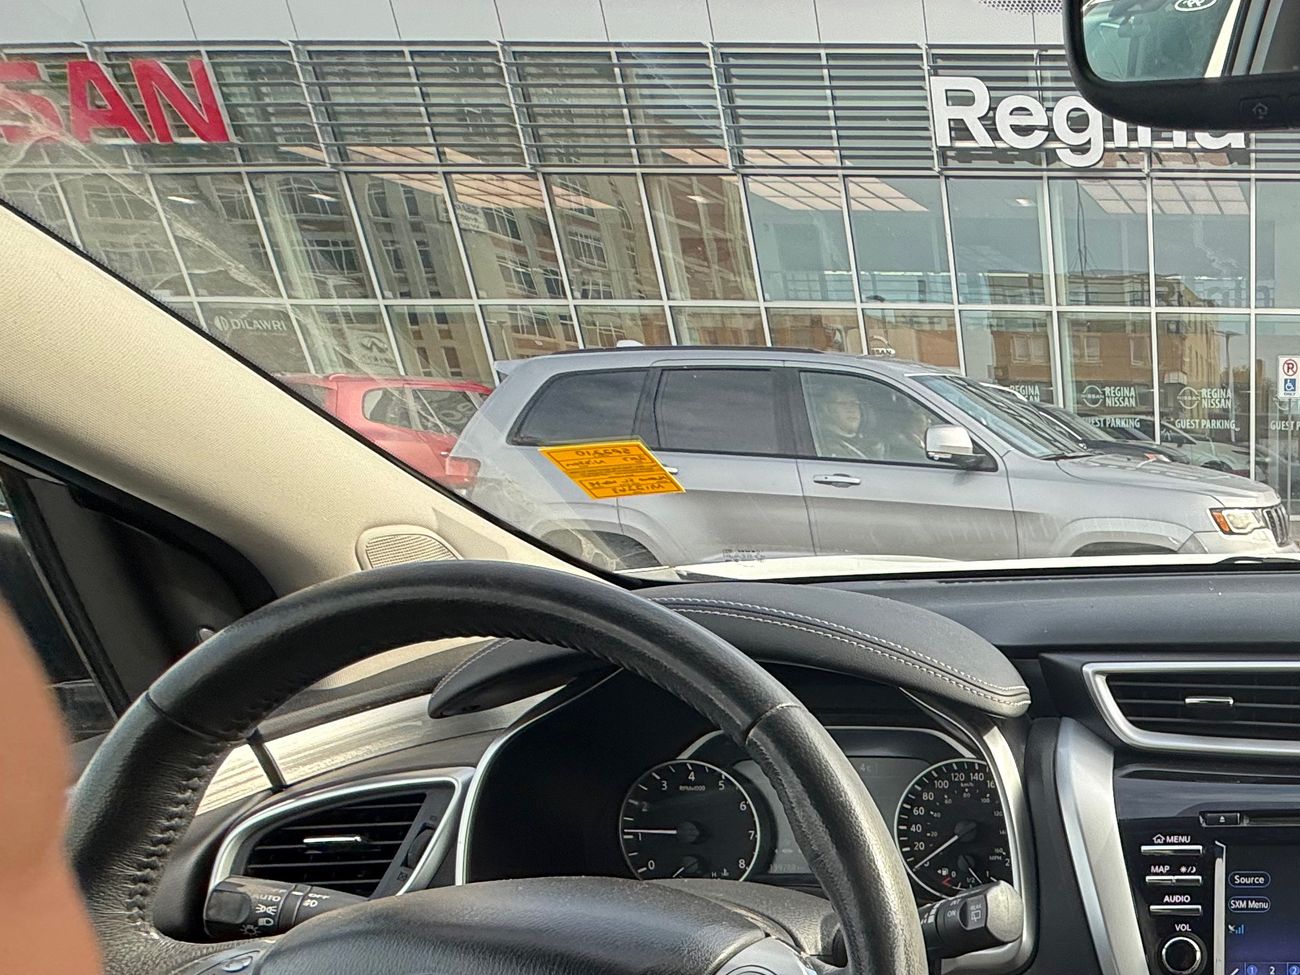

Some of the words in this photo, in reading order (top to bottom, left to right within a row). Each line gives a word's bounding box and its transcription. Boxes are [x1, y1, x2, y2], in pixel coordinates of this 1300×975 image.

[230, 319, 287, 331] DILAWRI
[1105, 386, 1136, 396] REGINA
[1202, 388, 1232, 398] REGINA
[1106, 397, 1136, 407] NISSAN
[1202, 399, 1232, 408] NISSAN
[1106, 418, 1140, 428] PARKING
[1175, 418, 1200, 429] GUEST
[1201, 418, 1236, 429] PARKING
[1270, 420, 1294, 430] GUEST
[688, 772, 695, 782] 4
[951, 773, 964, 781] 120
[970, 773, 984, 781] 140
[662, 781, 668, 790] 3
[718, 781, 725, 790] 5
[934, 780, 948, 788] 100
[642, 803, 648, 812] 2
[740, 802, 746, 810] 6
[913, 806, 924, 815] 60
[910, 824, 922, 832] 40
[749, 831, 755, 840] 7
[1166, 836, 1191, 844] MENU
[914, 842, 924, 850] 20
[648, 860, 655, 870] 0
[738, 859, 746, 868] 8
[1234, 876, 1265, 884] Source
[1230, 900, 1247, 908] SXM
[1248, 900, 1268, 909] Menu
[1269, 966, 1275, 975] 2
